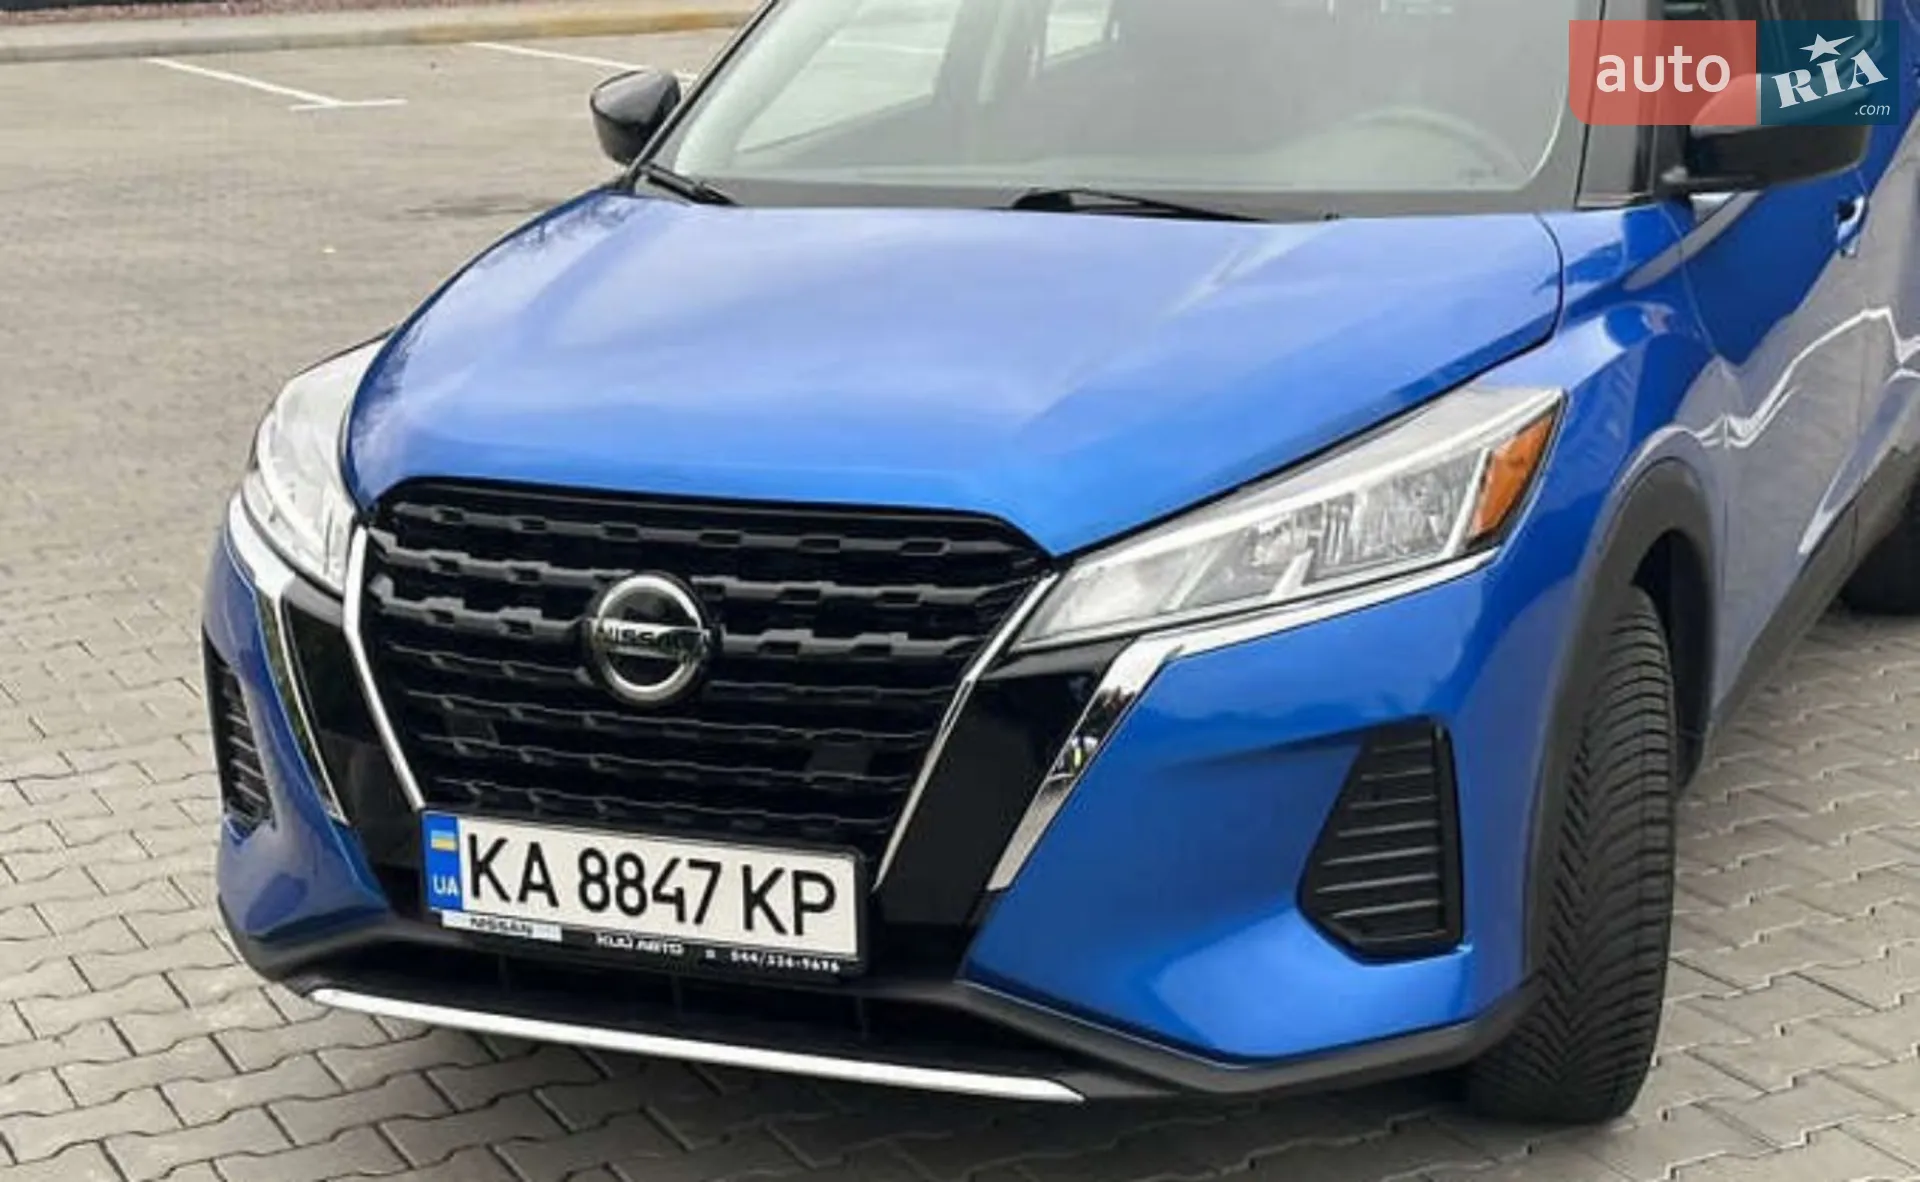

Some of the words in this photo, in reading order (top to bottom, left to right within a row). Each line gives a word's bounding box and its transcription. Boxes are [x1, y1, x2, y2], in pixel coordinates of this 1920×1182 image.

[433, 874, 457, 897] UA
[468, 833, 559, 908] KA
[577, 847, 722, 925] 8847
[741, 864, 836, 936] KP
